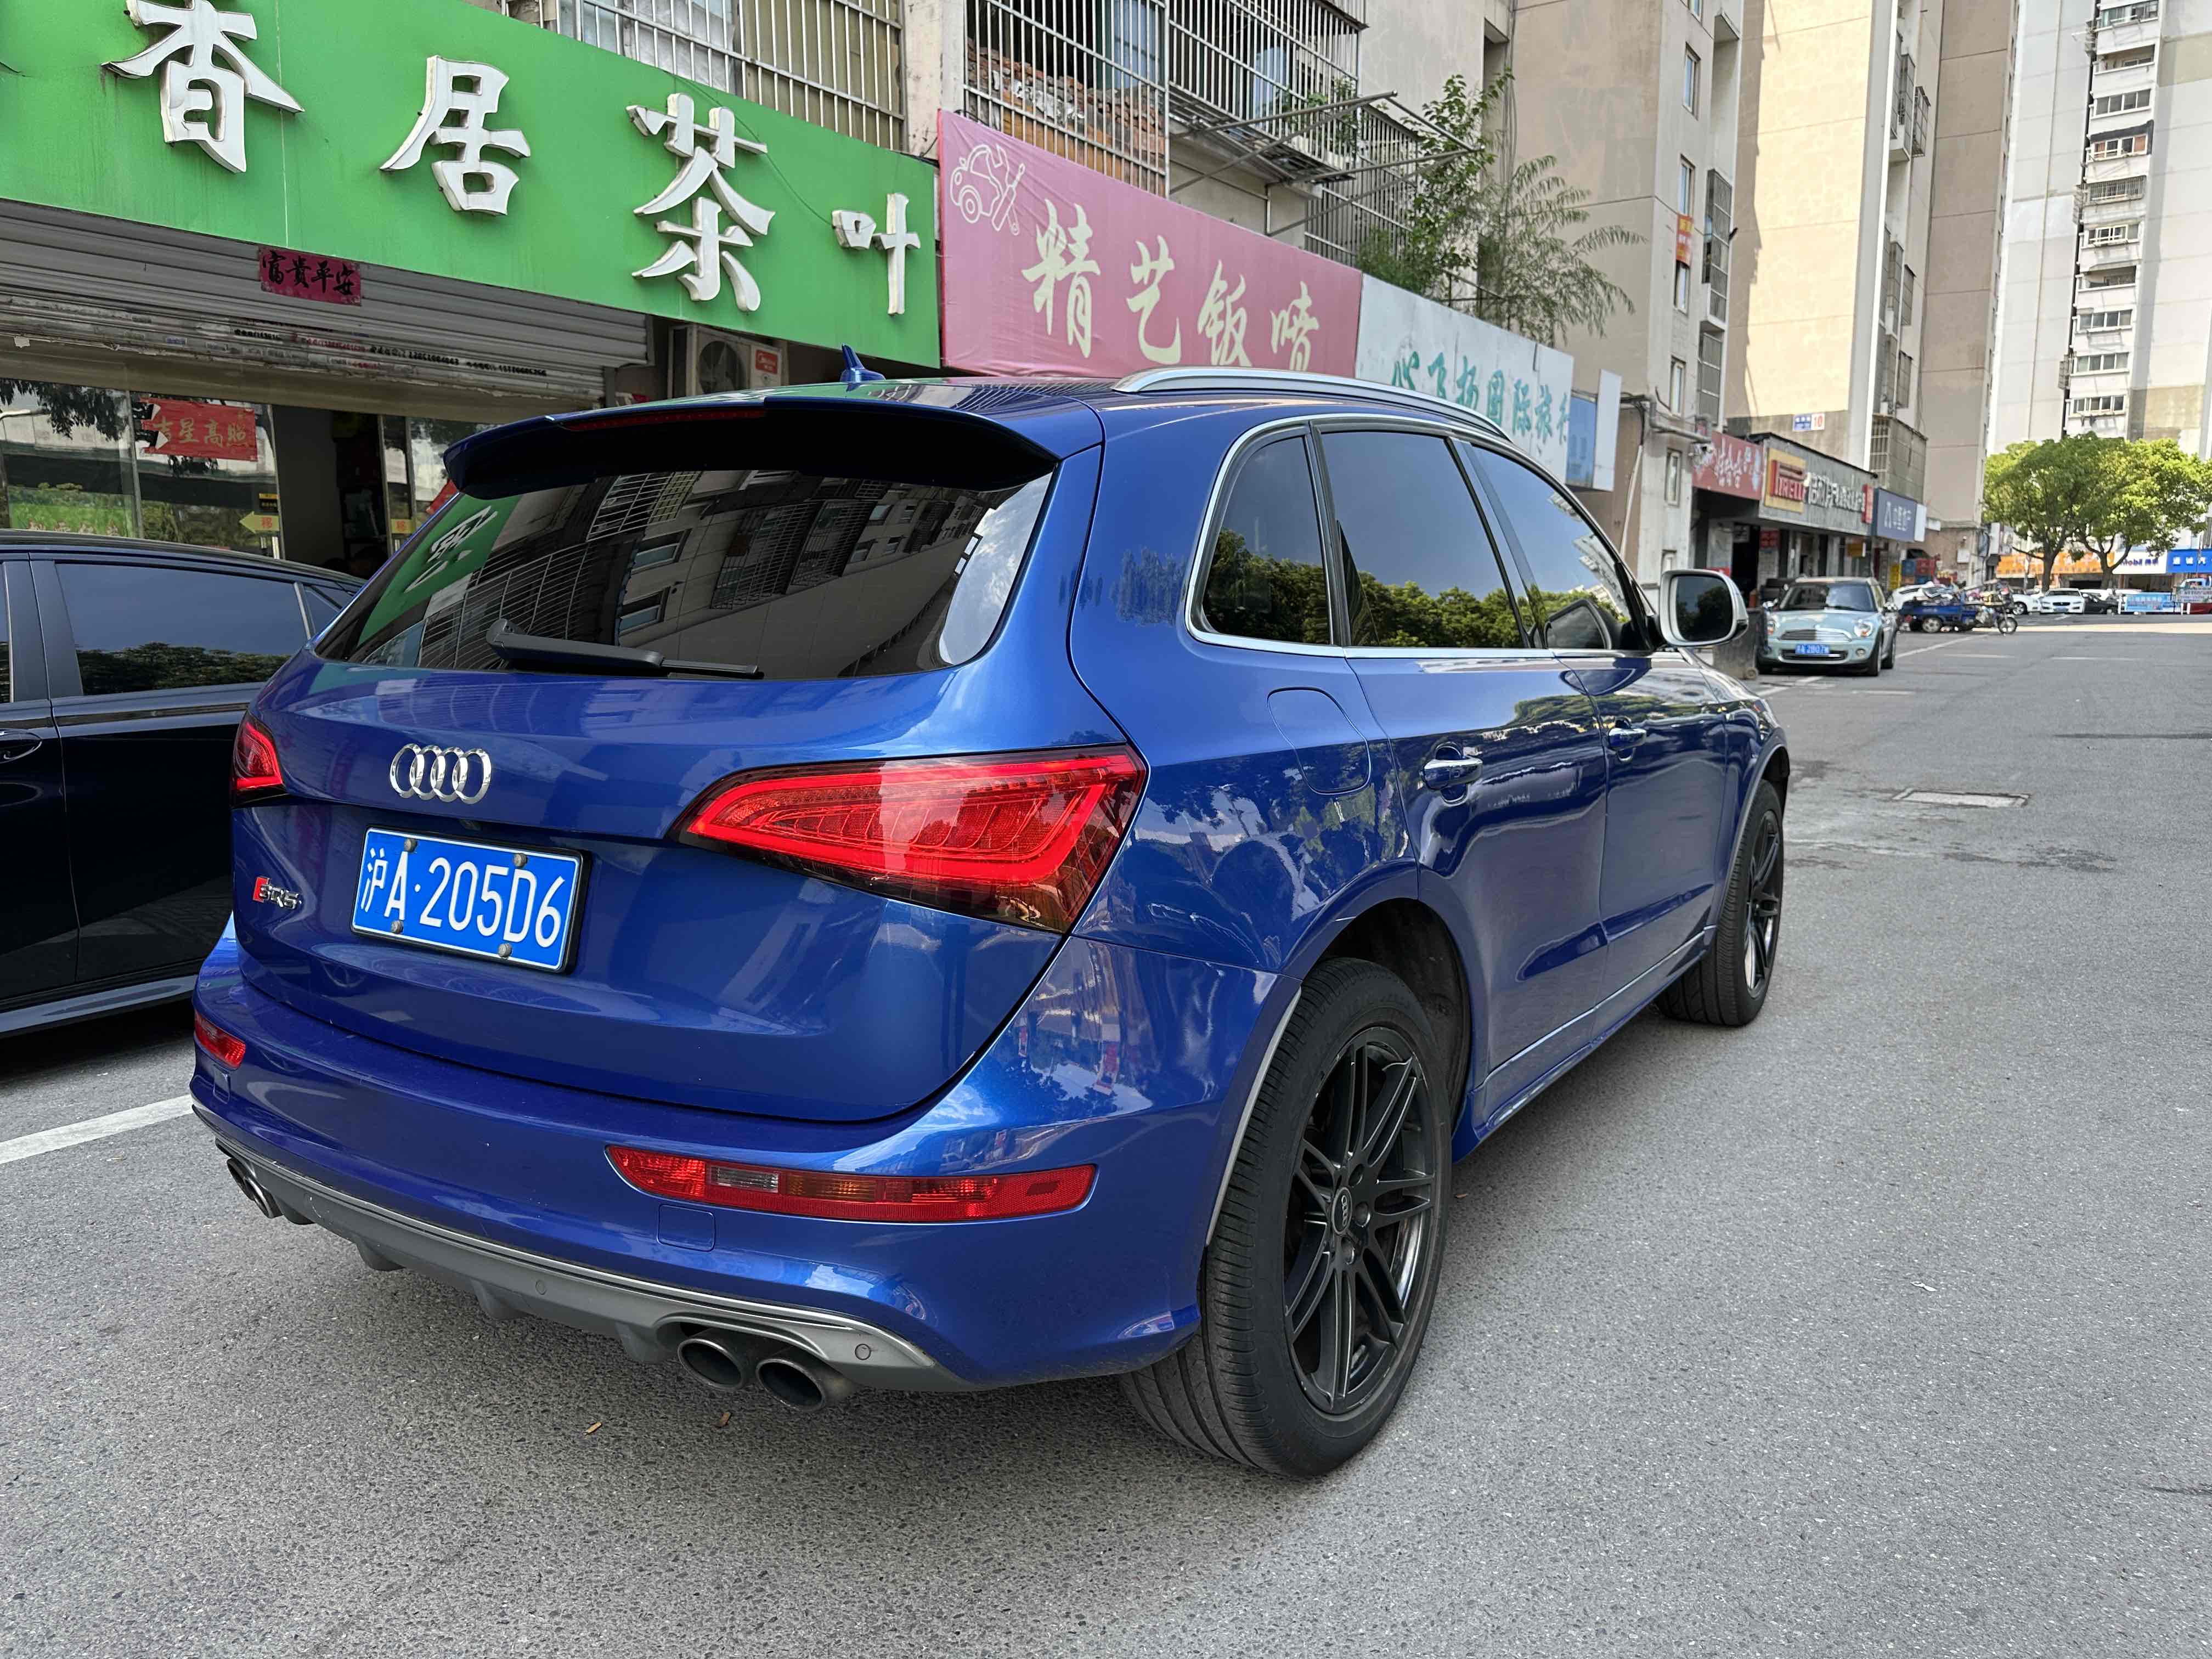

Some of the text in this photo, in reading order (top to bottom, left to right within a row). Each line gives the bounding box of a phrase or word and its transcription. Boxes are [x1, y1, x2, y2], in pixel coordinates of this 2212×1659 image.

[101, 0, 921, 315] 香居茶叶
[153, 416, 249, 449] 吉星高照
